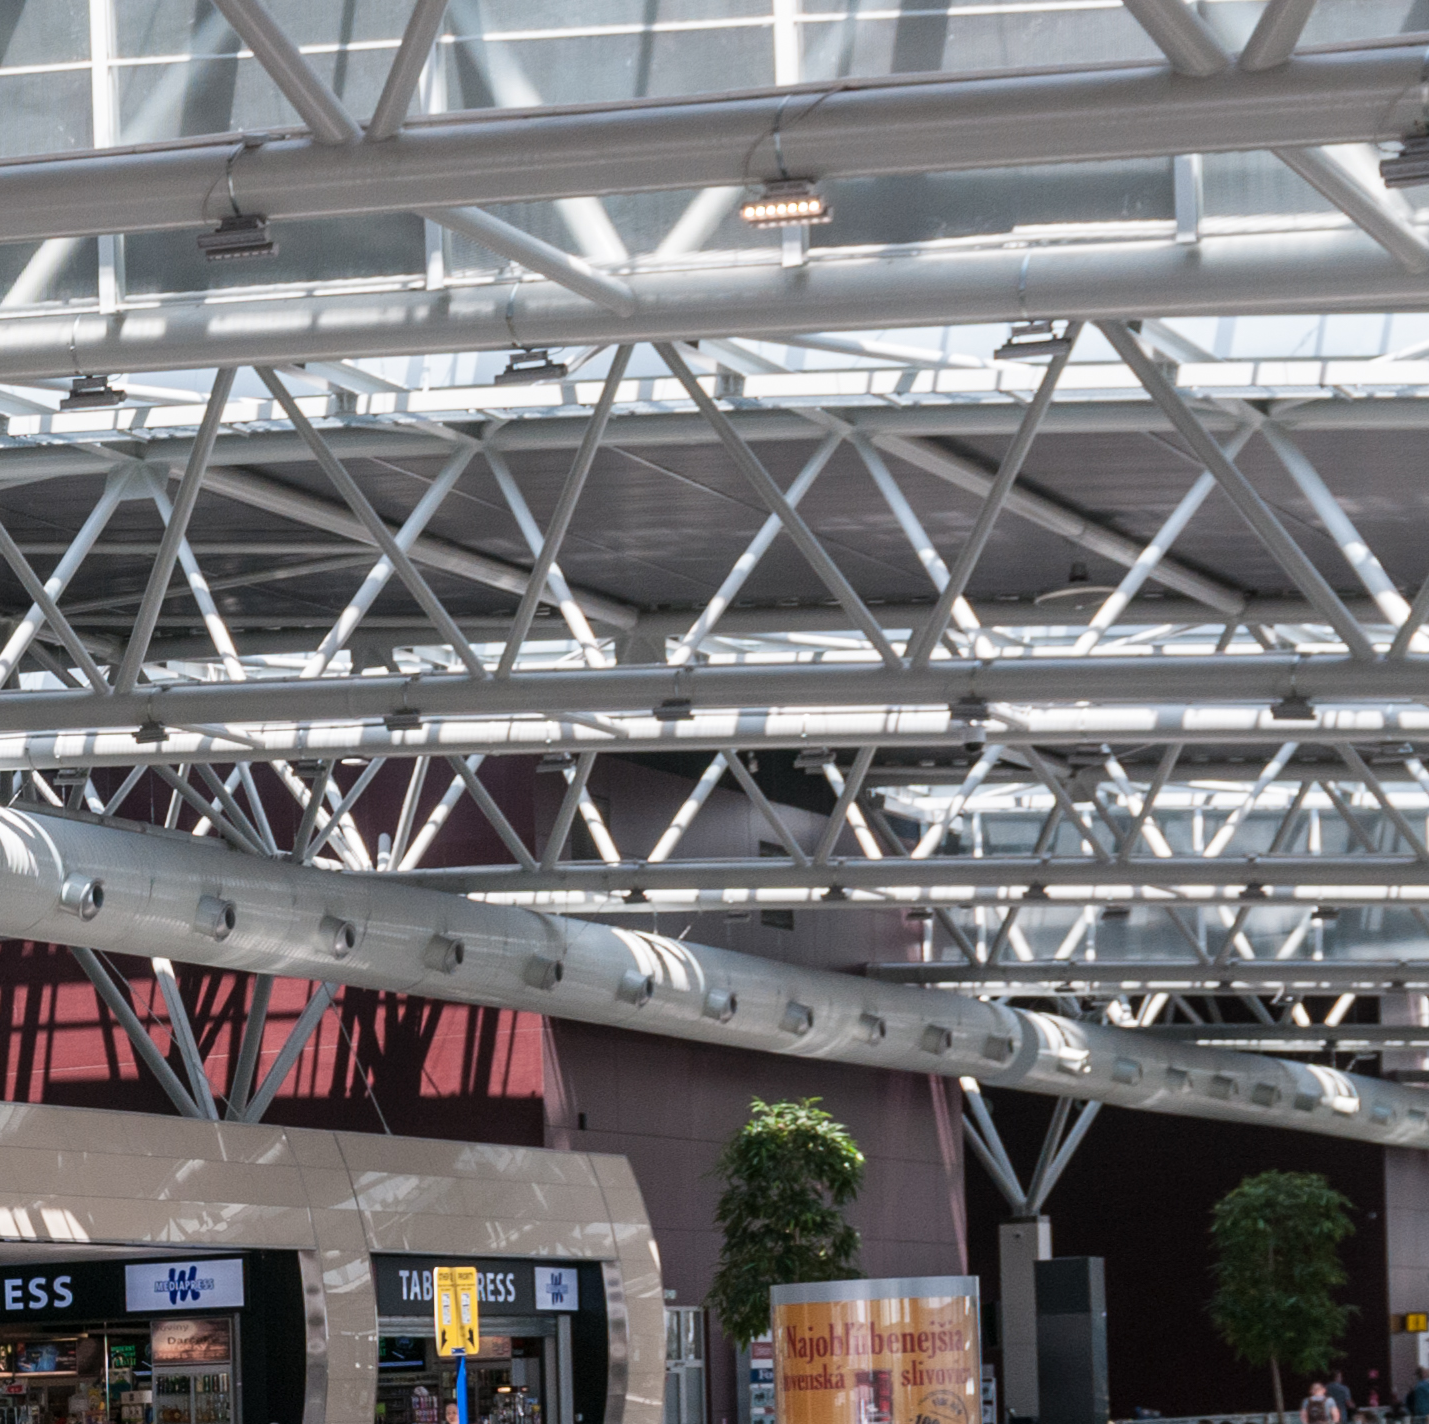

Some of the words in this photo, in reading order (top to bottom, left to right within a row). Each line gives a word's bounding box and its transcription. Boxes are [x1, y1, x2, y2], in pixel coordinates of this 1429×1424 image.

[153, 1278, 215, 1292] MEDIAPRESS
[398, 1269, 434, 1301] TAB
[477, 1271, 516, 1302] RESS
